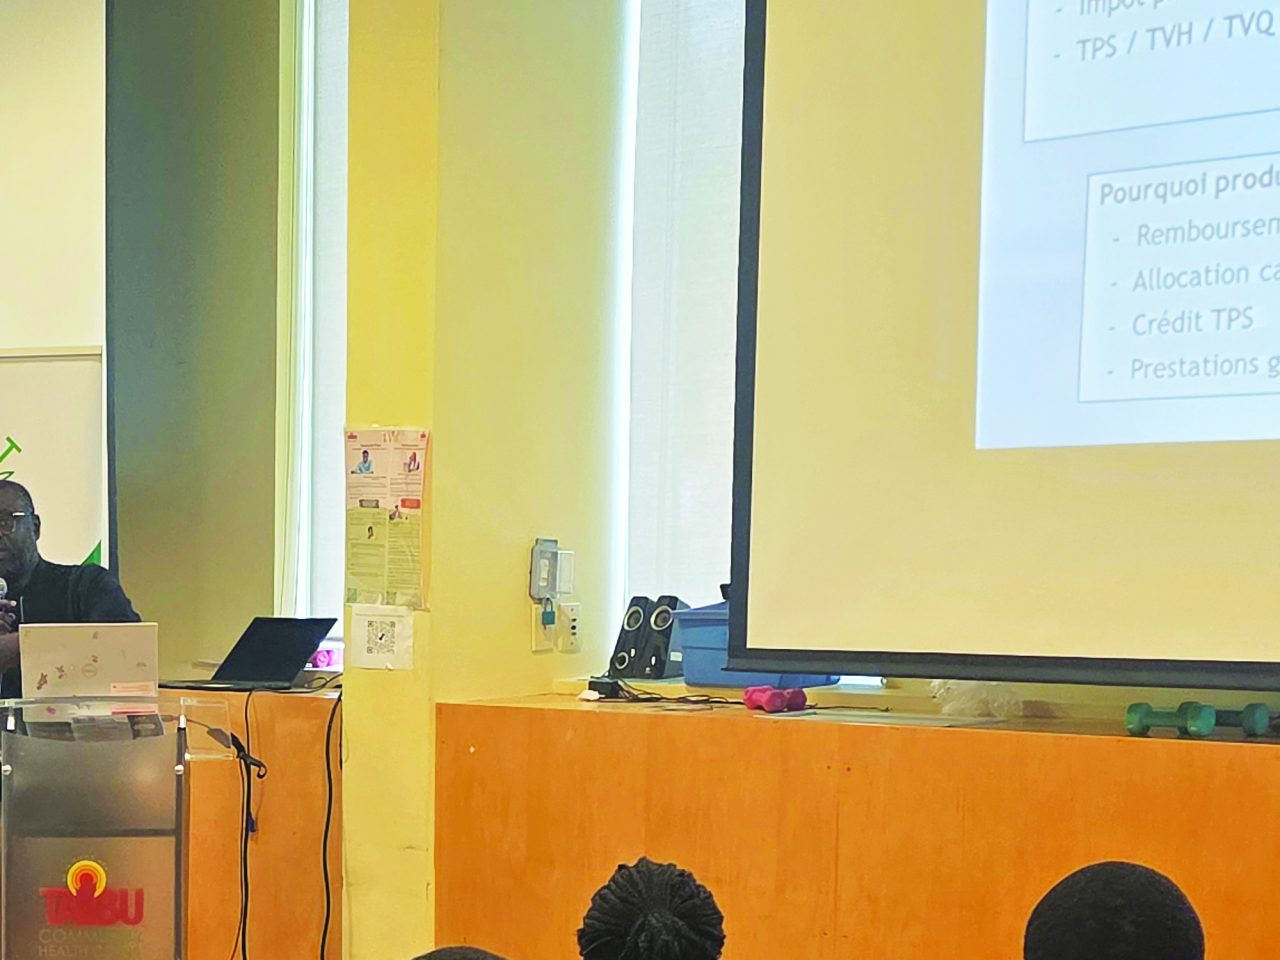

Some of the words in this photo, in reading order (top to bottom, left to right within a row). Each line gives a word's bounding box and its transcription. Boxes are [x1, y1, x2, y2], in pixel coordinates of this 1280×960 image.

[1077, 35, 1117, 61] TPS
[1146, 22, 1193, 50] TVH
[1224, 10, 1275, 38] TVQ
[1100, 172, 1207, 205] Pourquoi
[1133, 263, 1249, 292] Allocation
[1133, 310, 1203, 336] Crédit
[1211, 307, 1254, 331] TPS
[1131, 354, 1259, 379] Prestations
